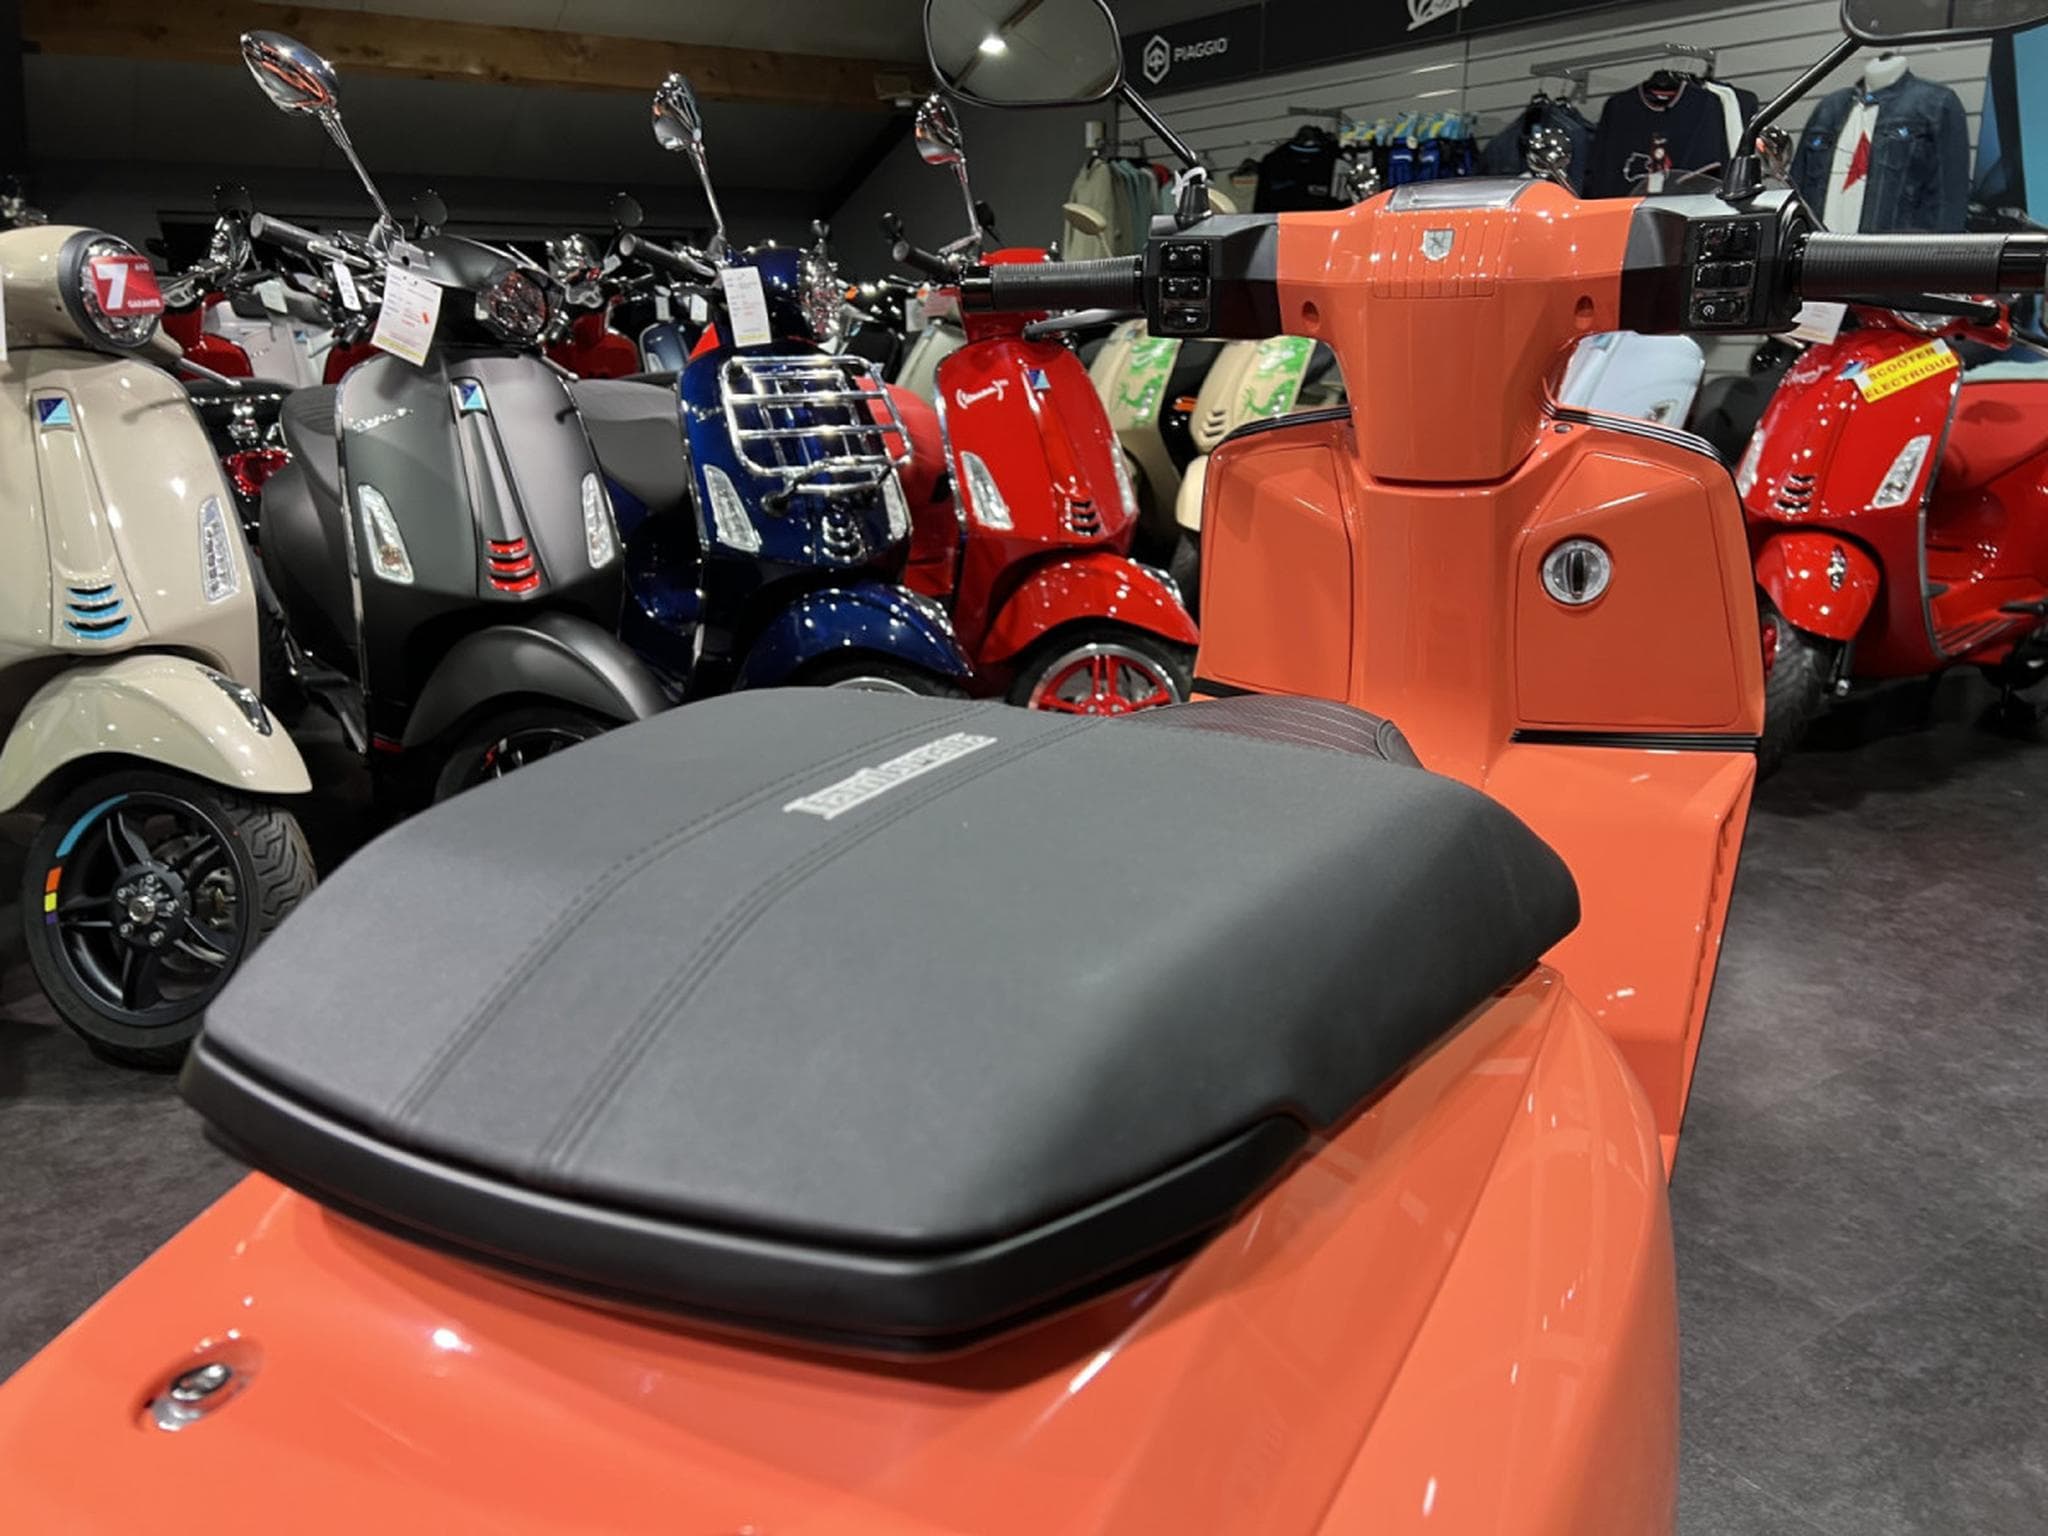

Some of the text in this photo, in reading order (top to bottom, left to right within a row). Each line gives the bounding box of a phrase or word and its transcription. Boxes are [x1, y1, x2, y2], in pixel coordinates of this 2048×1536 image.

[1173, 37, 1228, 62] PIAGGIO
[95, 263, 129, 311] 7
[1864, 355, 1954, 399] ELECTRIQUE
[1868, 346, 1937, 380] SCOOTER
